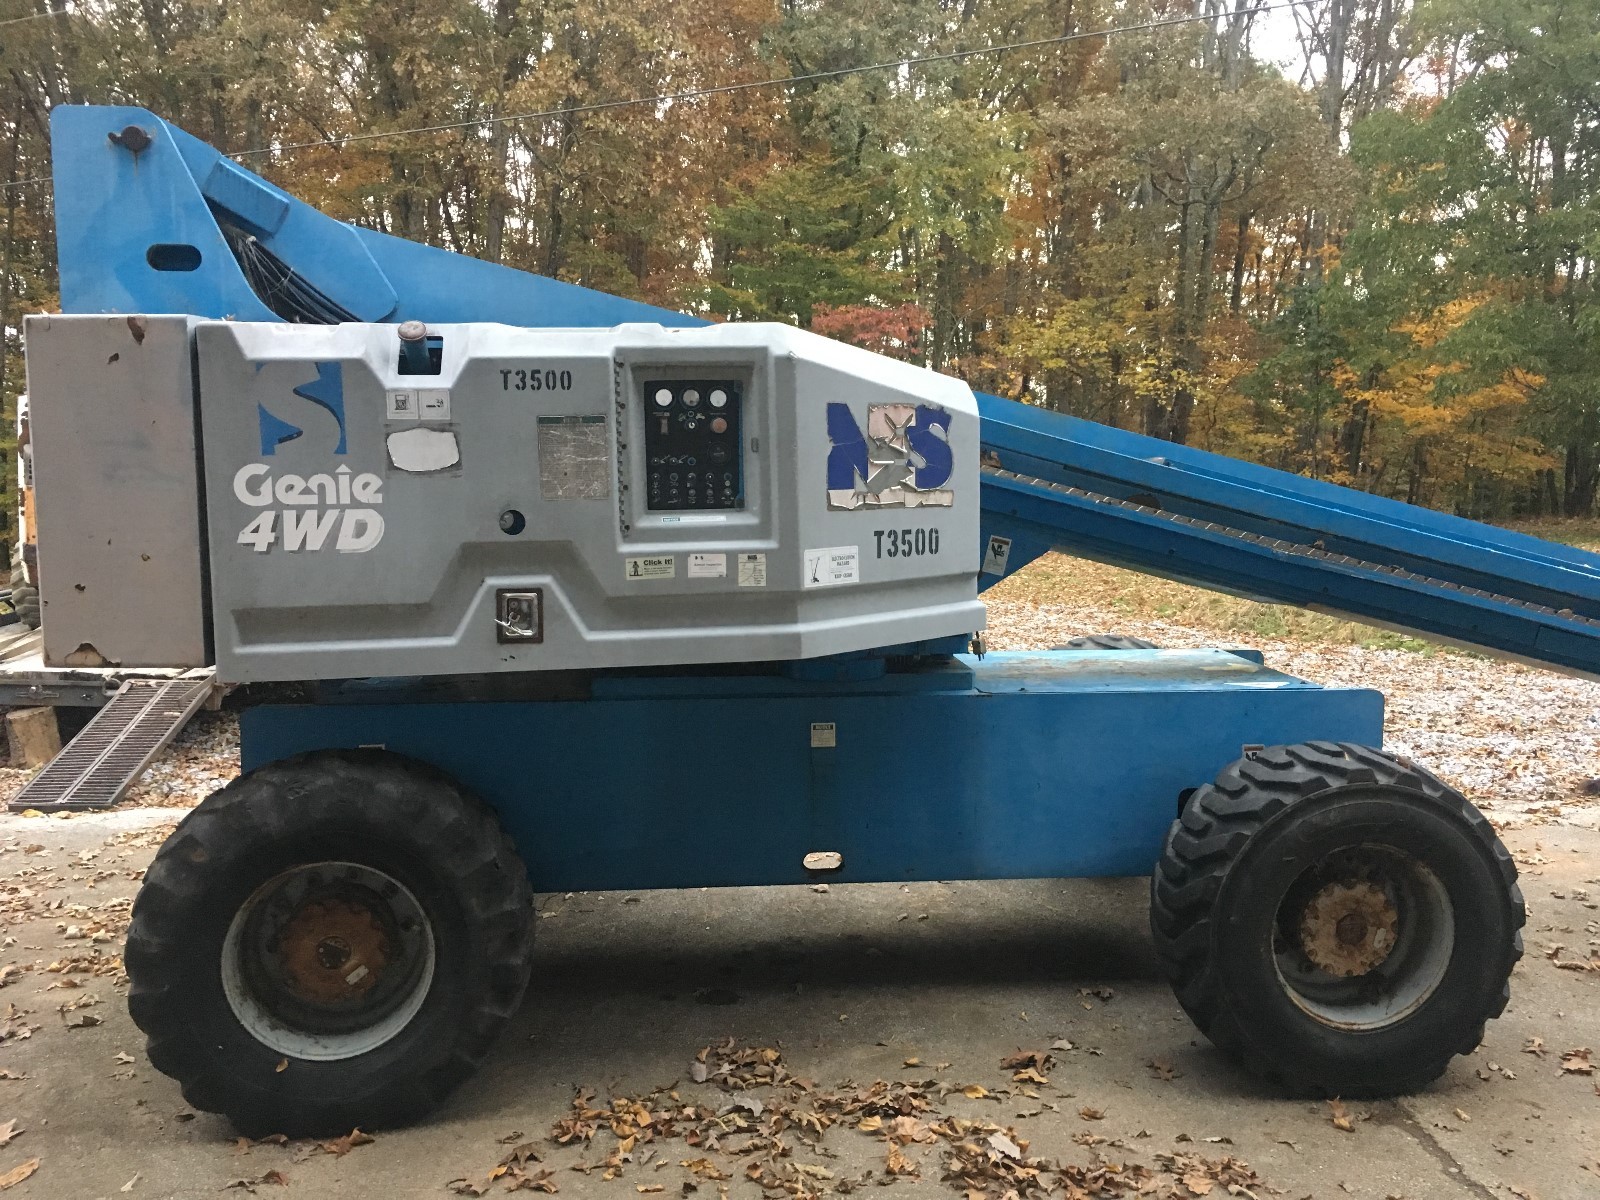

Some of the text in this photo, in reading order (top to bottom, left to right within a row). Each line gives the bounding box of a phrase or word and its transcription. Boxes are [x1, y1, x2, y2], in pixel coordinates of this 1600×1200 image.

[500, 369, 572, 391] T3500
[233, 463, 383, 507] Genie
[237, 508, 385, 554] 4WD
[873, 527, 940, 559] T3500
